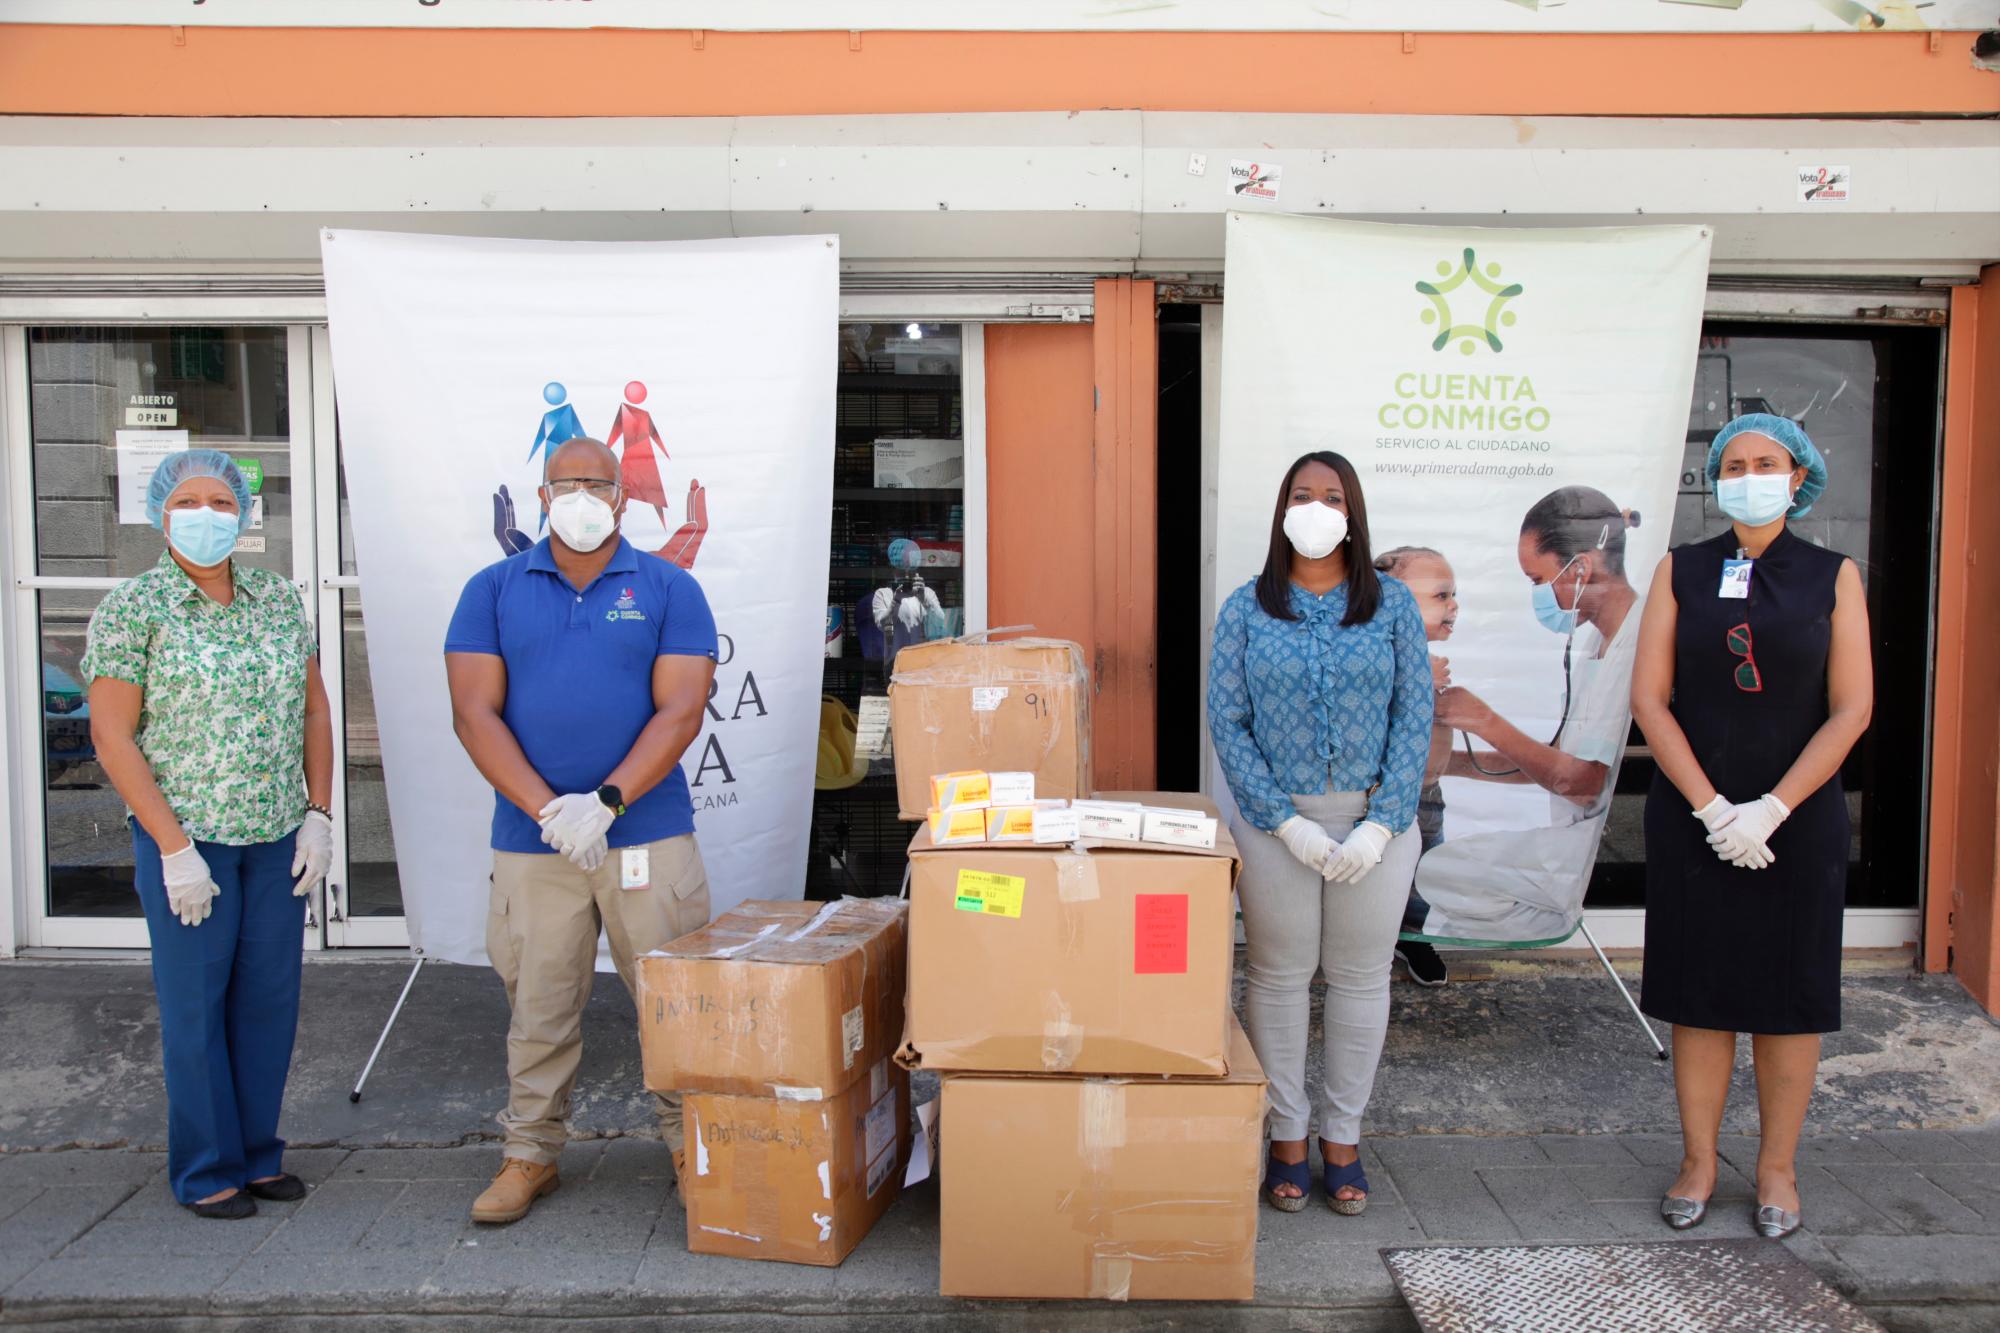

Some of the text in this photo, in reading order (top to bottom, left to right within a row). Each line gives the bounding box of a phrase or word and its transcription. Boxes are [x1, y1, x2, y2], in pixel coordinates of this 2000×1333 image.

[1231, 163, 1259, 181] Vota 2
[1799, 167, 1827, 185] Vota 2
[1394, 372, 1537, 402] CUENTA
[130, 394, 174, 406] ABIERTO
[137, 413, 168, 422] OPEN
[1377, 402, 1551, 432] CONMIGO
[1375, 437, 1551, 452] SERVICIO AL CIUDADANO
[1375, 460, 1554, 479] www.primeradama.gob.do
[235, 540, 263, 548] PUJAR
[1025, 693, 1047, 720] 91
[691, 732, 736, 787] A
